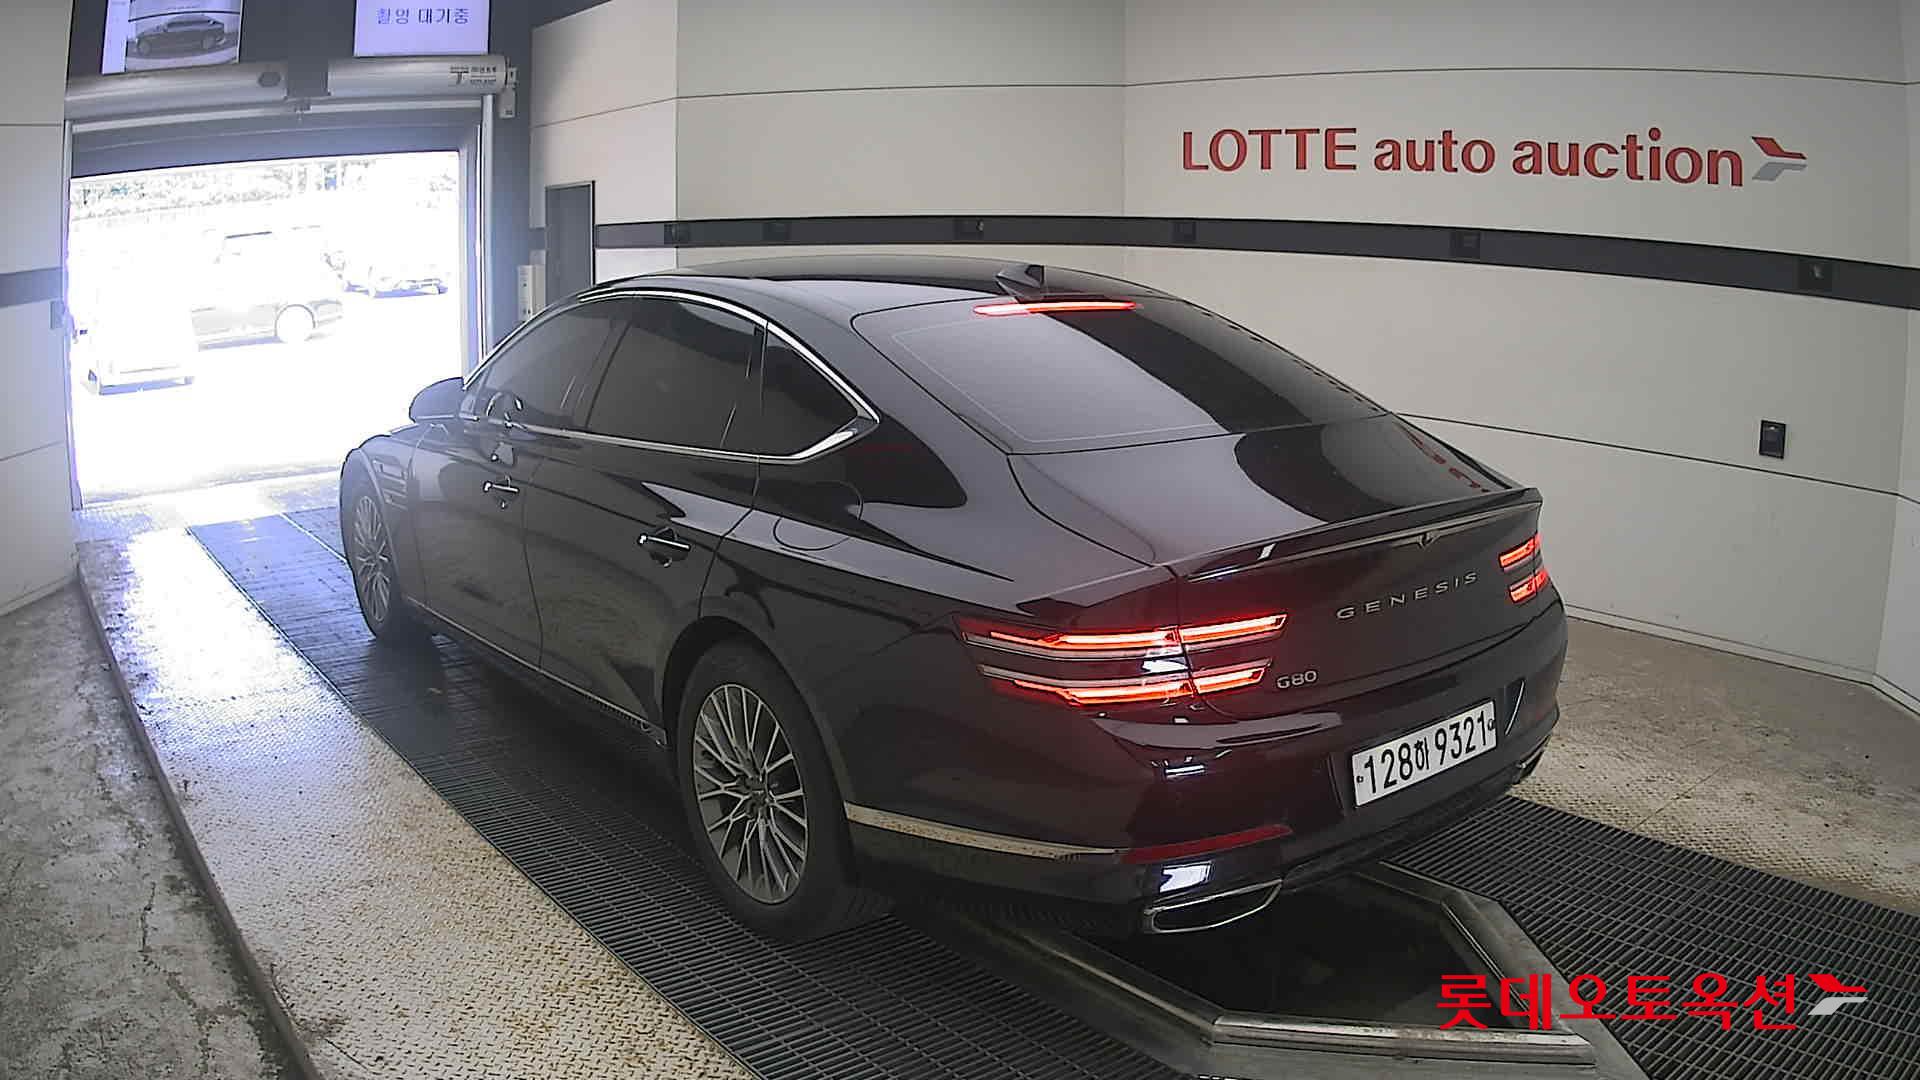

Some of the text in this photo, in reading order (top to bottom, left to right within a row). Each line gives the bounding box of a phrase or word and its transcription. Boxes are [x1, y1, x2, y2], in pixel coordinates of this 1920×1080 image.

[418, 7, 470, 25] 대기중
[1182, 127, 1744, 187] LOTTE auto auction
[1335, 571, 1478, 620] GENESIS
[1276, 669, 1318, 690] G80
